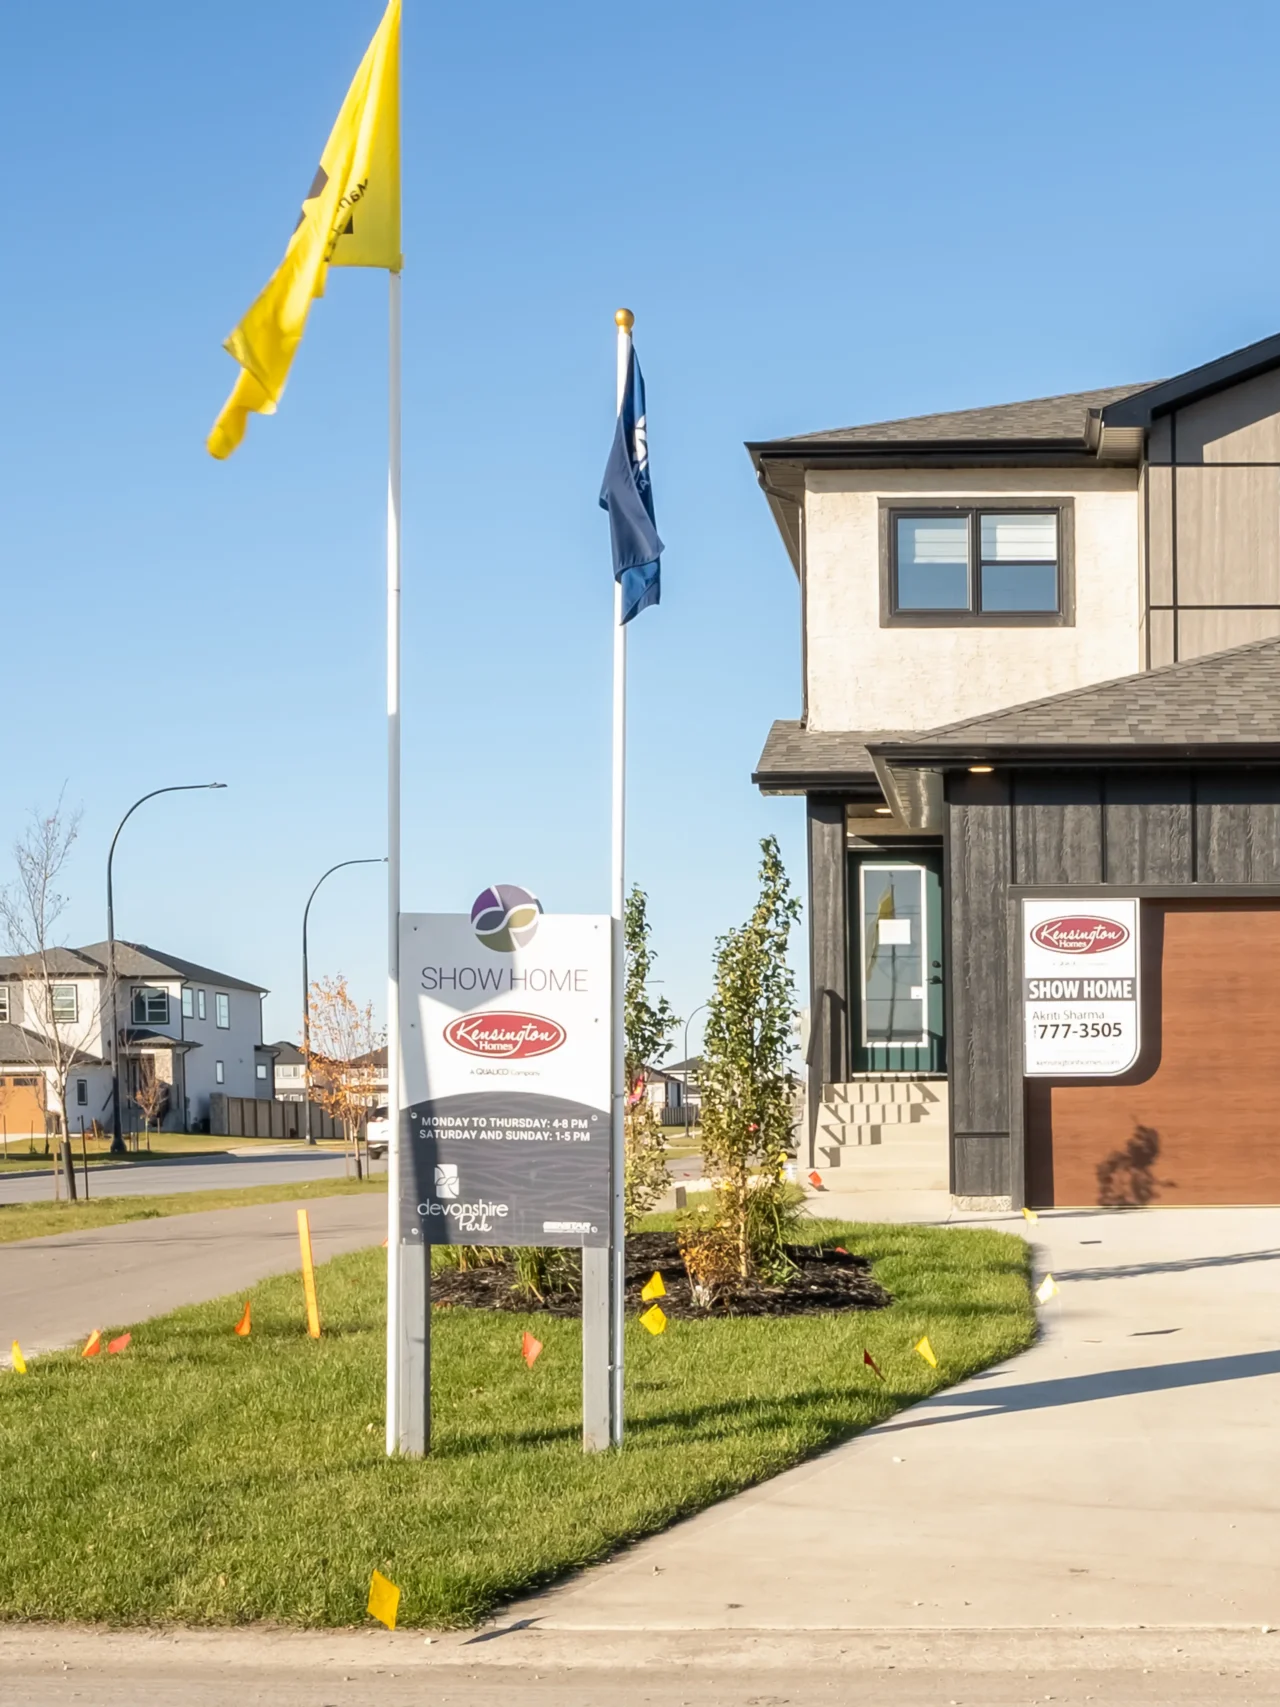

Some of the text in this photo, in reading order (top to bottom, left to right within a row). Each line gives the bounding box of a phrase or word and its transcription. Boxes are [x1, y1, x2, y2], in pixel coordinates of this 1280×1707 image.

[1041, 921, 1122, 946] Kensington
[1059, 940, 1087, 948] Homes
[421, 966, 588, 992] SHOW HOME
[1028, 980, 1133, 999] SHOW HOME
[1063, 1010, 1105, 1021] Sharma
[456, 1019, 557, 1048] Kensington
[1038, 1022, 1123, 1040] 777-3505
[479, 1041, 514, 1051] Homes
[421, 1116, 588, 1129] MONDAY TO THURSDAY: 4-8 PM
[419, 1129, 591, 1142] SATURDAY AND SUNDAY: 1-5 PM
[417, 1198, 509, 1218] devonshire
[454, 1213, 493, 1232] Park
